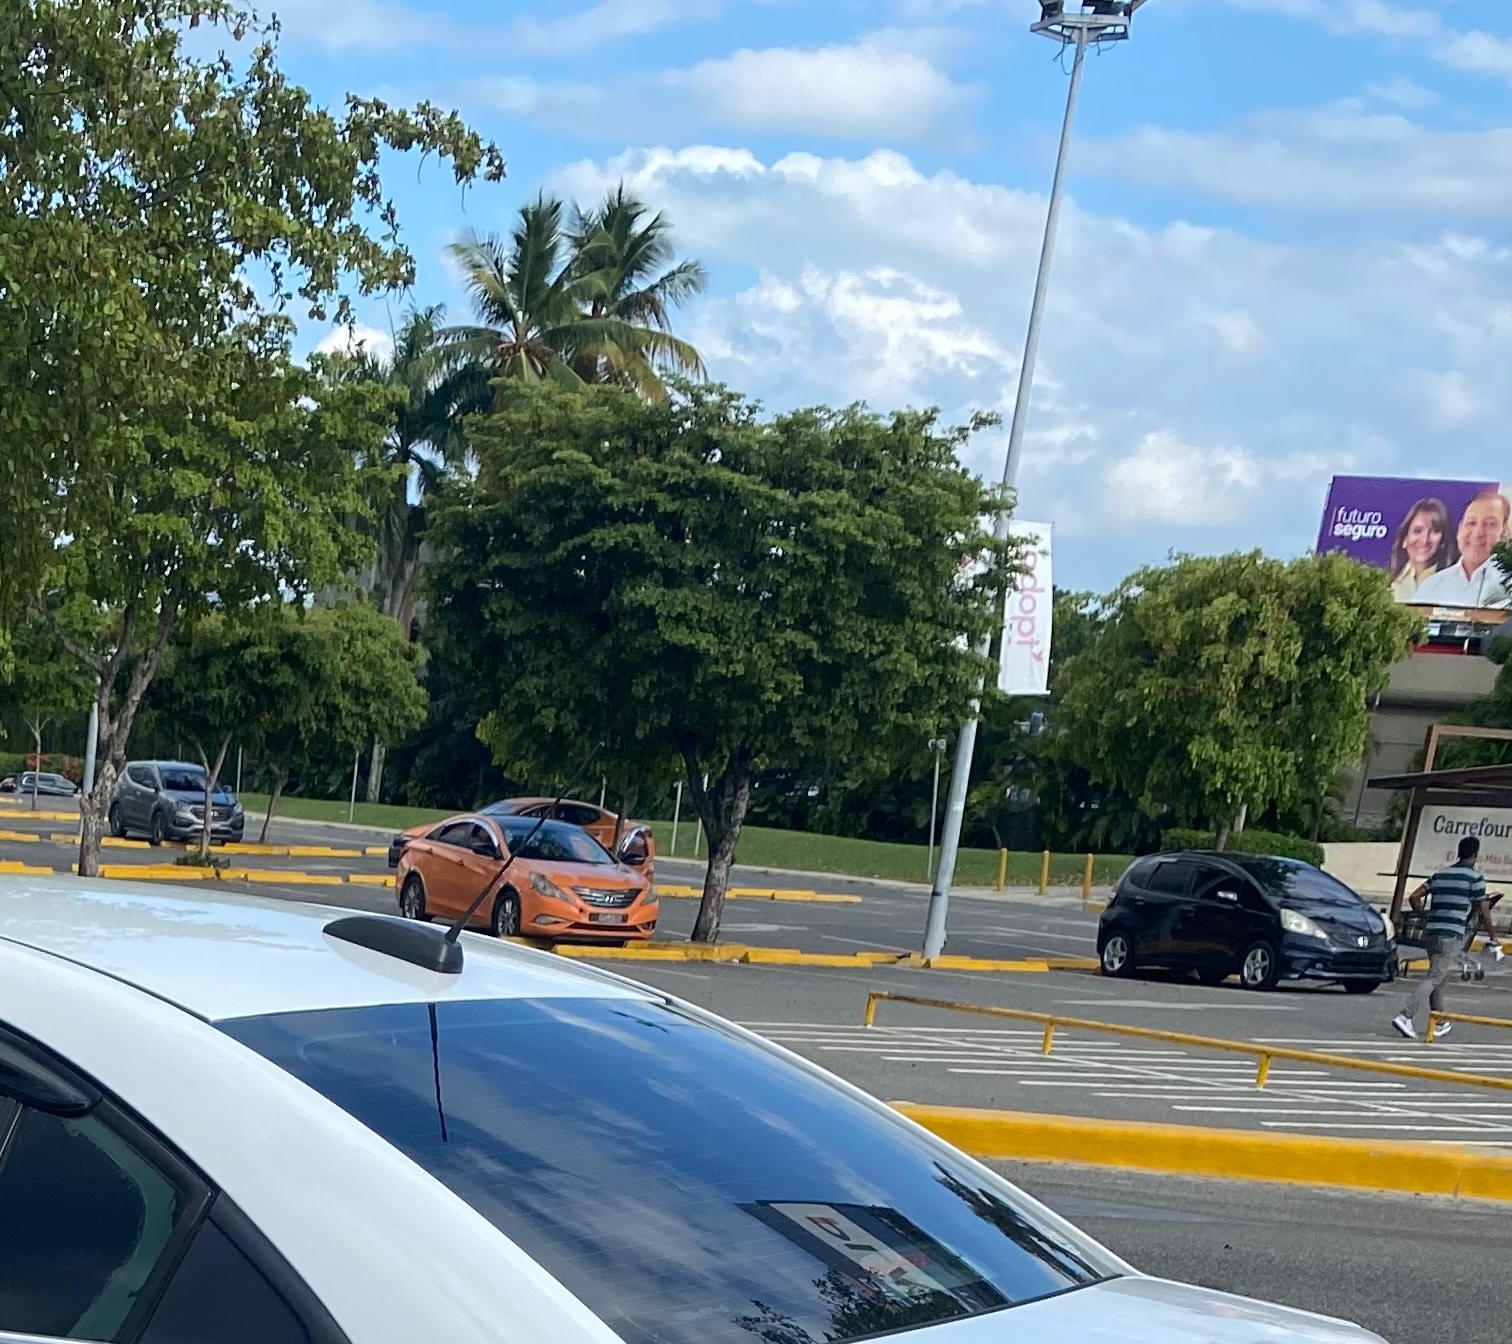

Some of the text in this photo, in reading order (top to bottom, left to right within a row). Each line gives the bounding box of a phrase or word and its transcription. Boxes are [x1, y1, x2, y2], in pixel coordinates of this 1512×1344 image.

[1337, 506, 1381, 524] futuro
[1333, 523, 1387, 540] seguro
[1433, 815, 1512, 838] Carrefour
